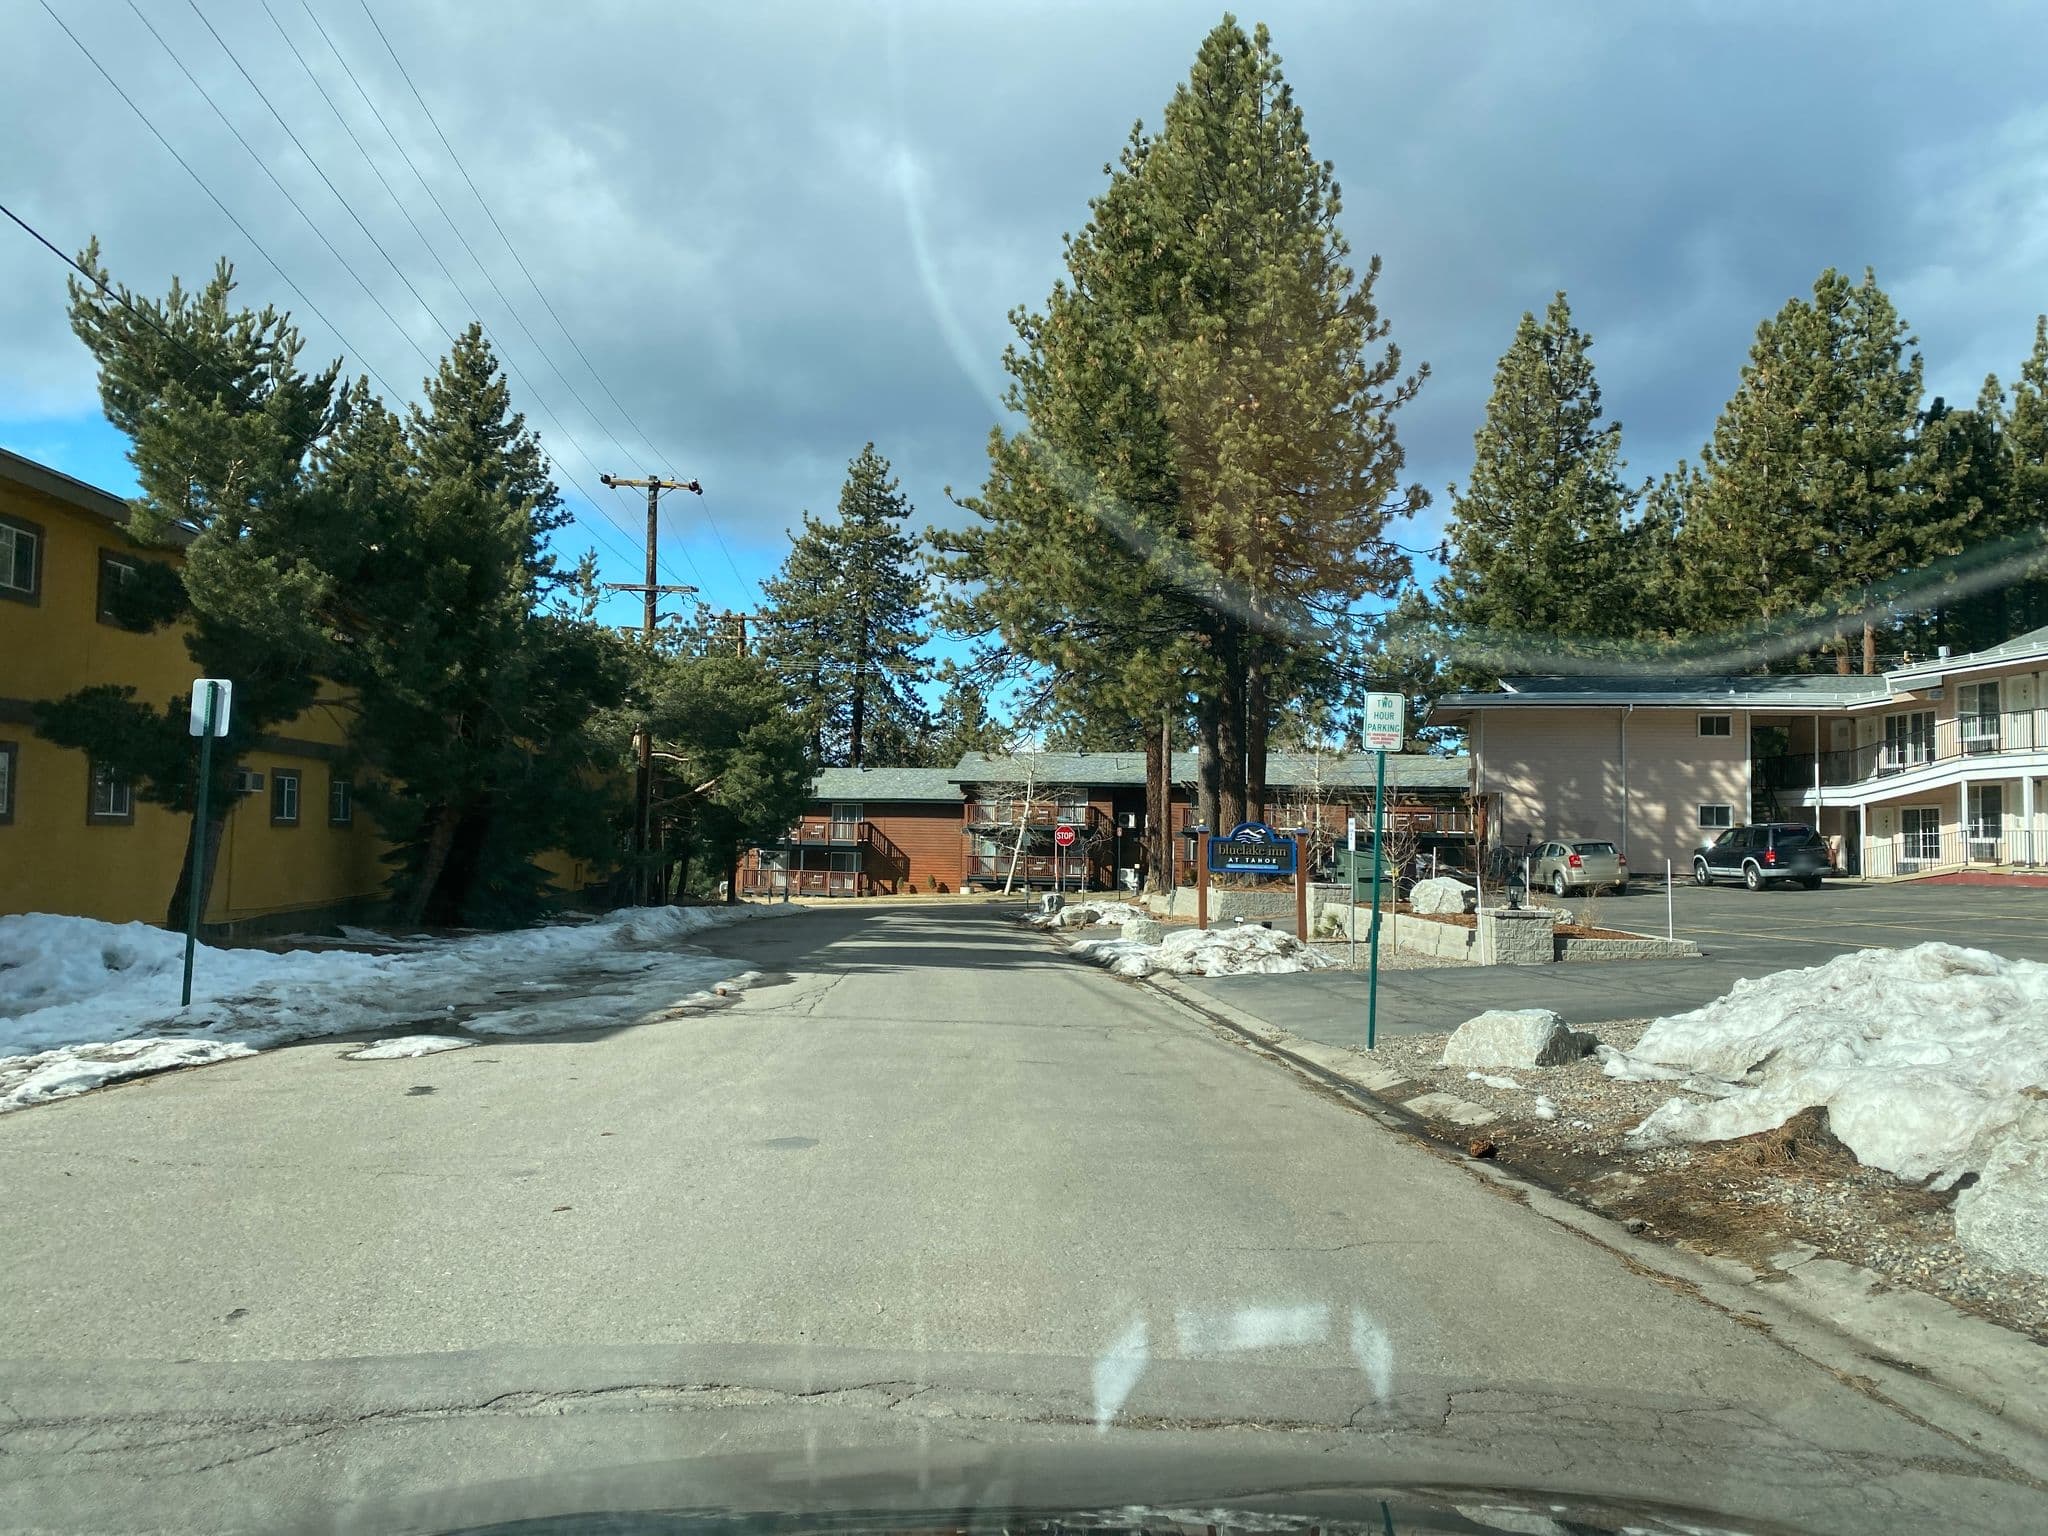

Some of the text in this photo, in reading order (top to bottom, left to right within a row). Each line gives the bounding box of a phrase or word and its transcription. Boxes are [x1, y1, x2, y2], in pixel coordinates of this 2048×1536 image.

[1377, 700, 1392, 708] TWO
[1374, 712, 1395, 720] HOUR
[1367, 723, 1400, 732] PARKING
[1056, 832, 1073, 840] STOP
[1218, 844, 1287, 857] bluelake inn
